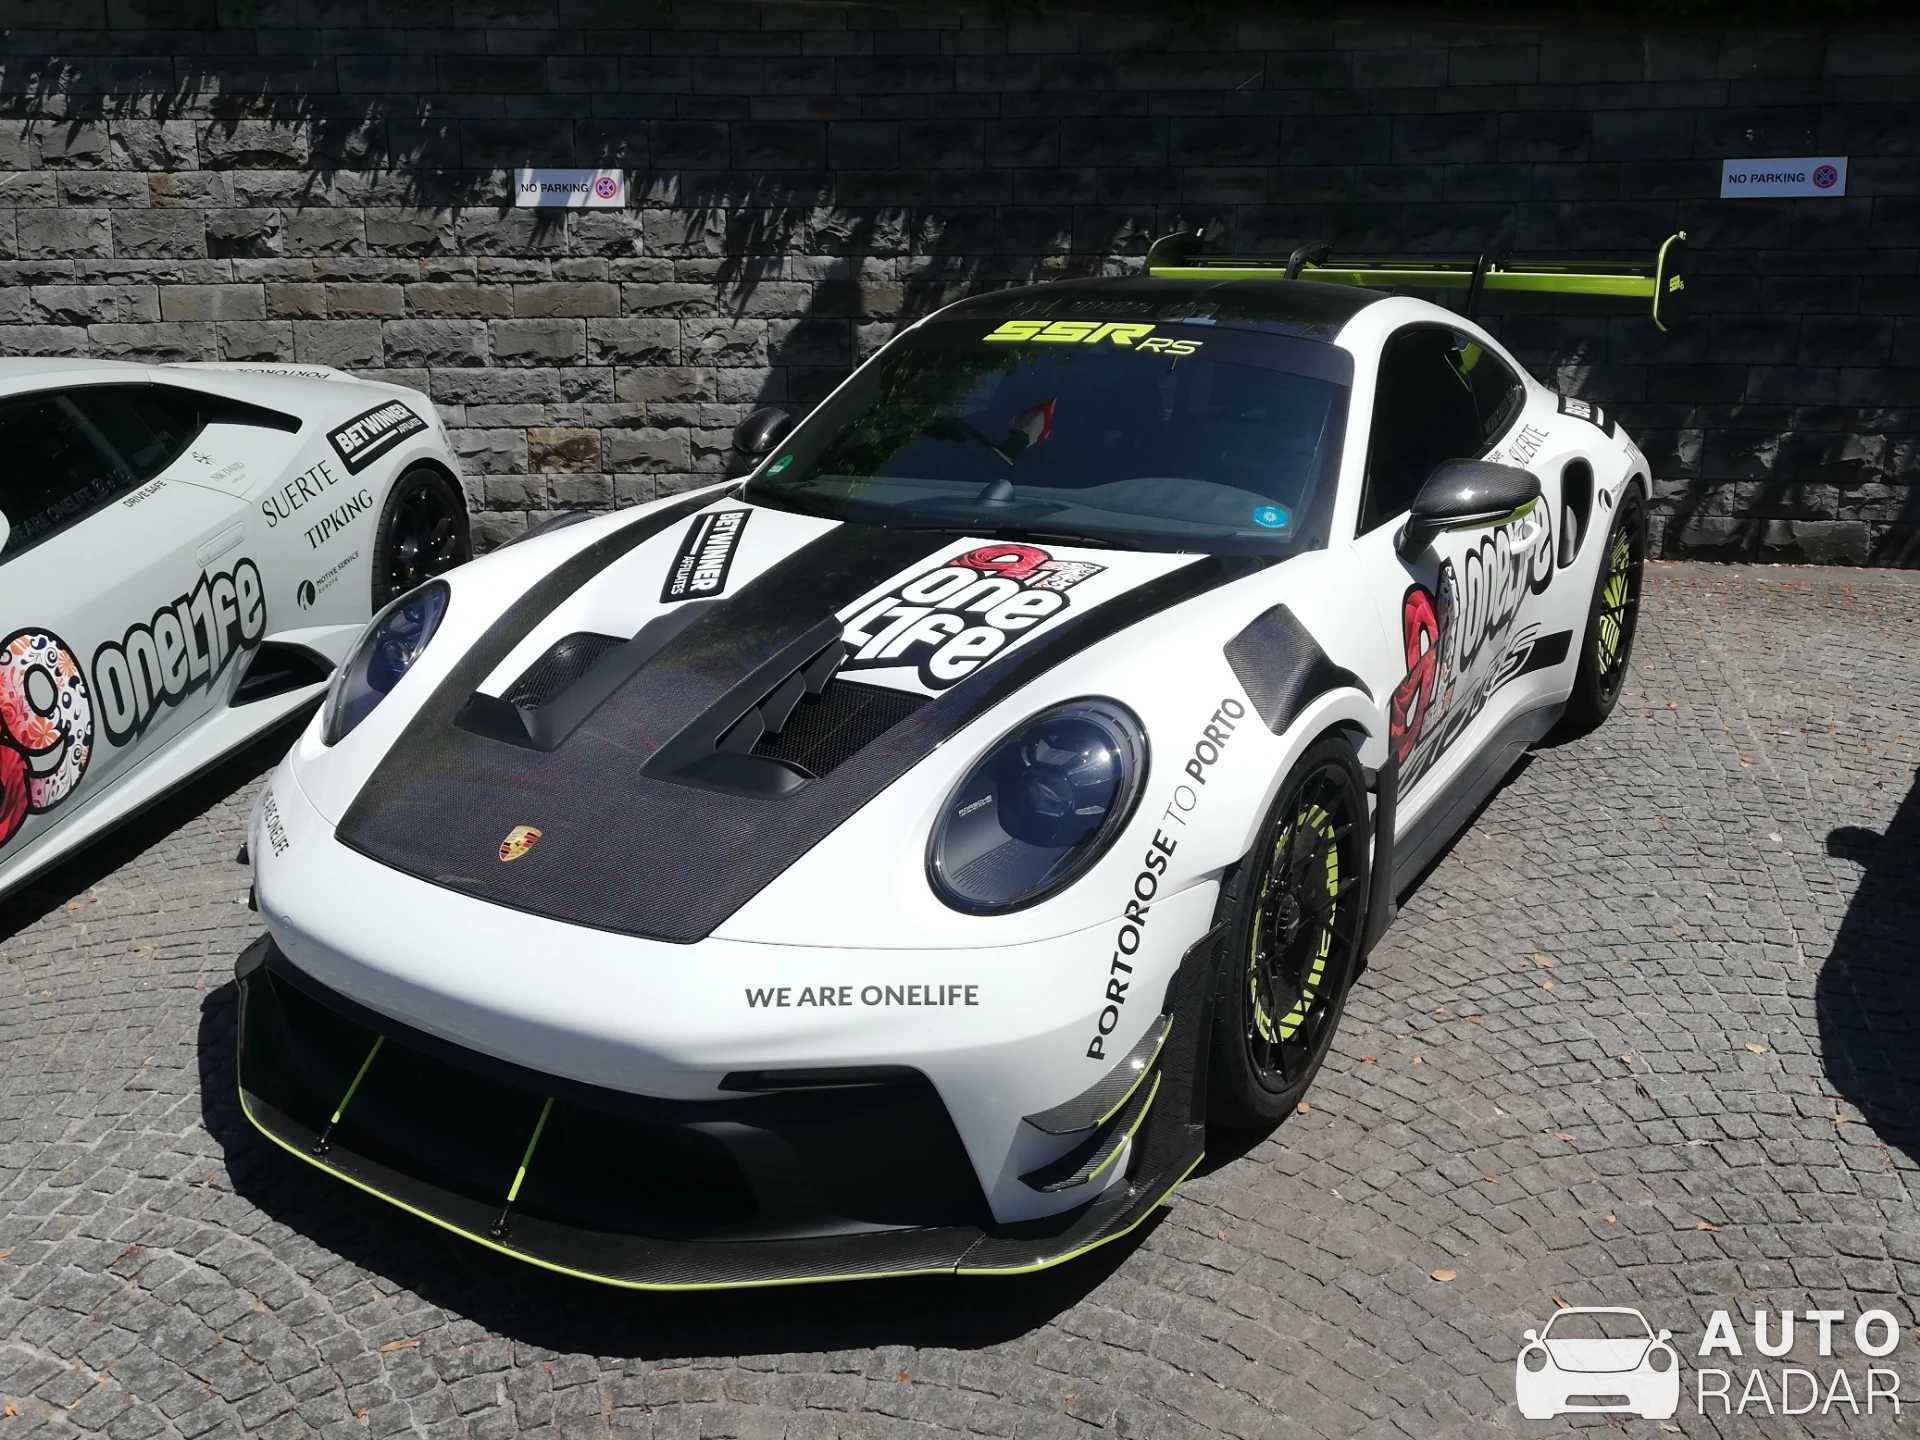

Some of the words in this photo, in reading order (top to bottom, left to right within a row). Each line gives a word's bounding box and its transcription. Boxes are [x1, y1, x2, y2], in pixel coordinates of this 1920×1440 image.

[521, 183, 538, 193] NO
[541, 183, 589, 193] PARKING
[1728, 173, 1747, 184] NO
[1750, 172, 1806, 183] PARKING
[982, 320, 1156, 345] SSR
[1135, 337, 1204, 356] RS
[335, 403, 412, 454] BETWINNER
[399, 417, 423, 434] AFFILIATES
[1508, 423, 1550, 470] SUERTE
[122, 490, 151, 508] DRIVE
[148, 479, 168, 496] SAFE
[261, 460, 339, 528] SUERTE
[304, 488, 374, 550] TIPKING
[689, 512, 745, 592] BETWINNER
[316, 566, 338, 587] MOTIVE
[670, 555, 696, 595] AFFILIATES
[1086, 828, 1178, 1061] PORTOROSE
[1162, 785, 1197, 826] TO
[1185, 697, 1246, 786] PORTO
[744, 987, 792, 1008] WE
[796, 986, 854, 1007] ARE
[860, 984, 980, 1006] ONELIFE
